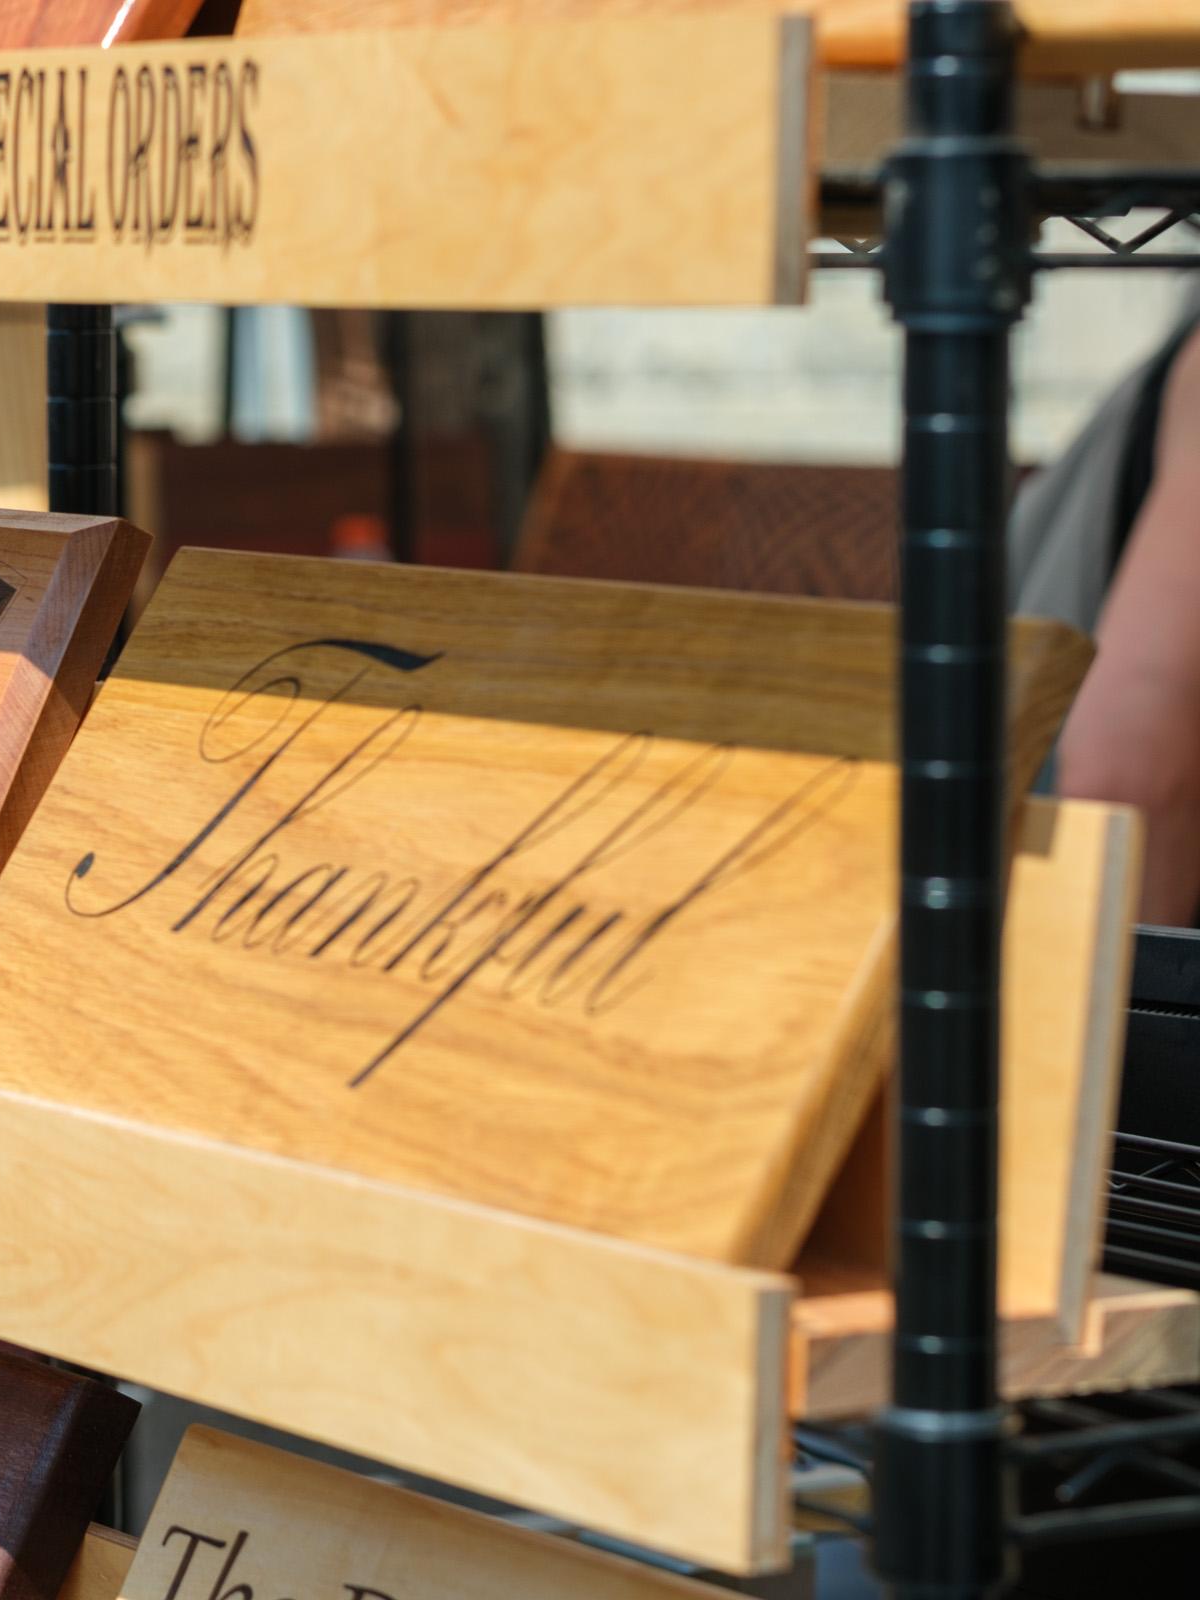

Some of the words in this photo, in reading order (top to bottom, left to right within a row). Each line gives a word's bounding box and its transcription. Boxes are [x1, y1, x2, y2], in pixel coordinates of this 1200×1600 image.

[107, 59, 261, 258] ORDERS
[65, 638, 862, 1088] Thankful
[161, 1524, 297, 1600] Th
